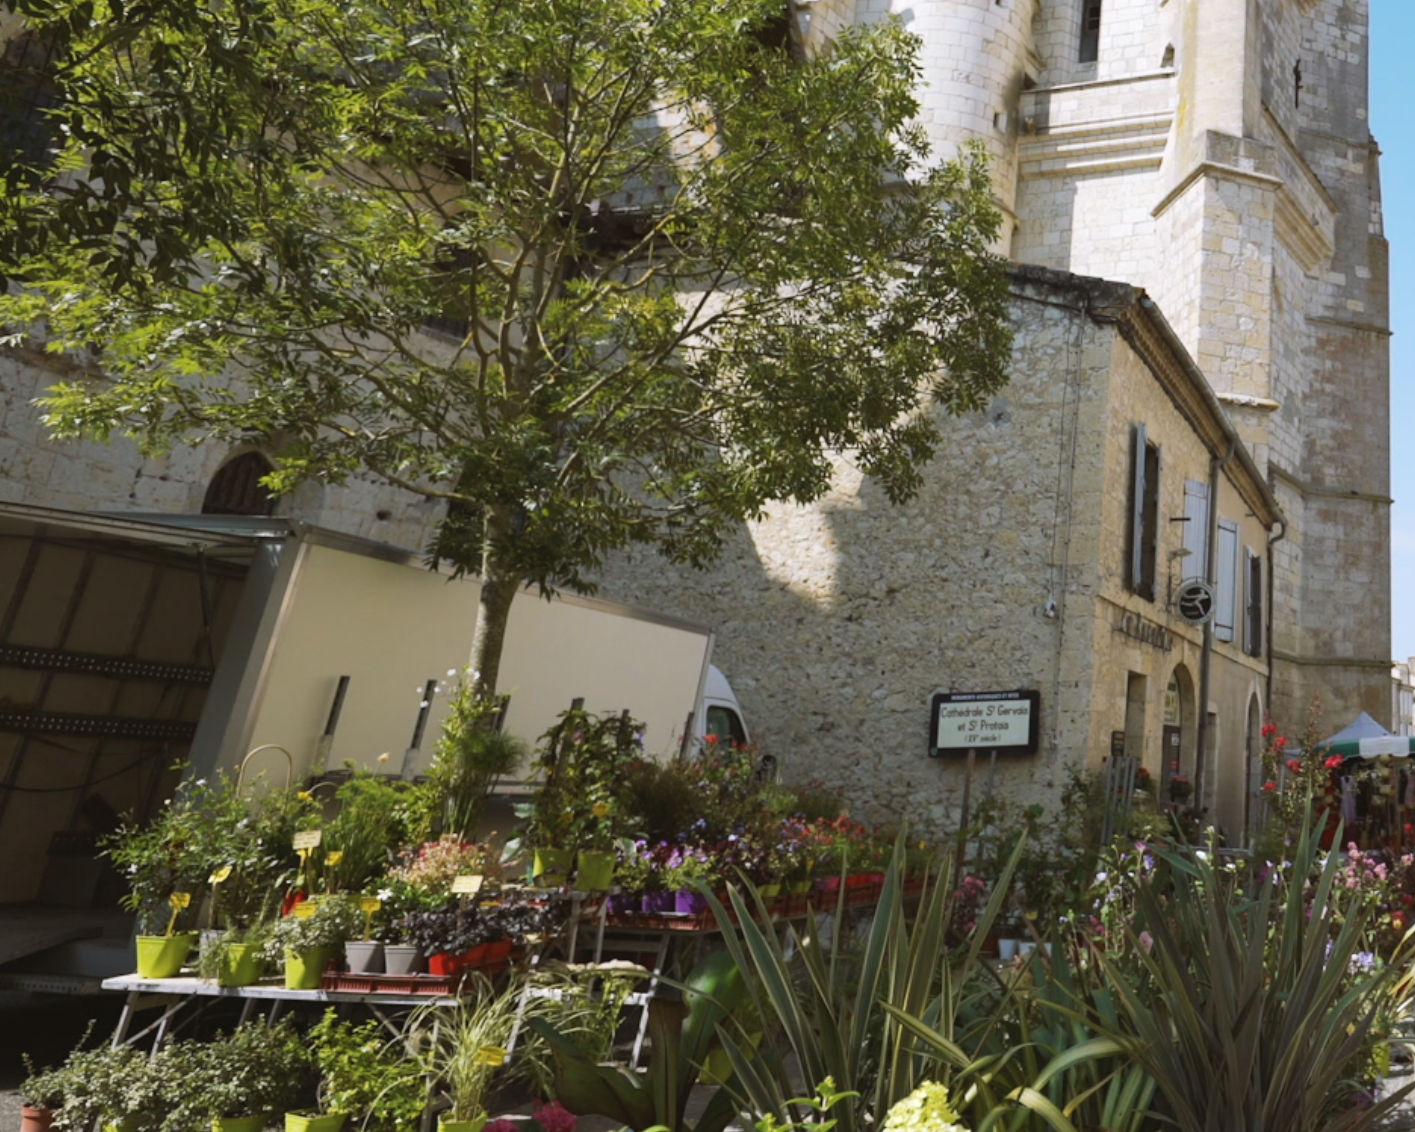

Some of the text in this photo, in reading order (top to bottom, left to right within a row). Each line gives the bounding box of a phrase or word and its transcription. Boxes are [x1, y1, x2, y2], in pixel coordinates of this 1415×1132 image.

[941, 706, 983, 718] Cathédrale
[997, 704, 1028, 716] Gervais
[957, 723, 966, 732] et
[980, 720, 1009, 731] Protais
